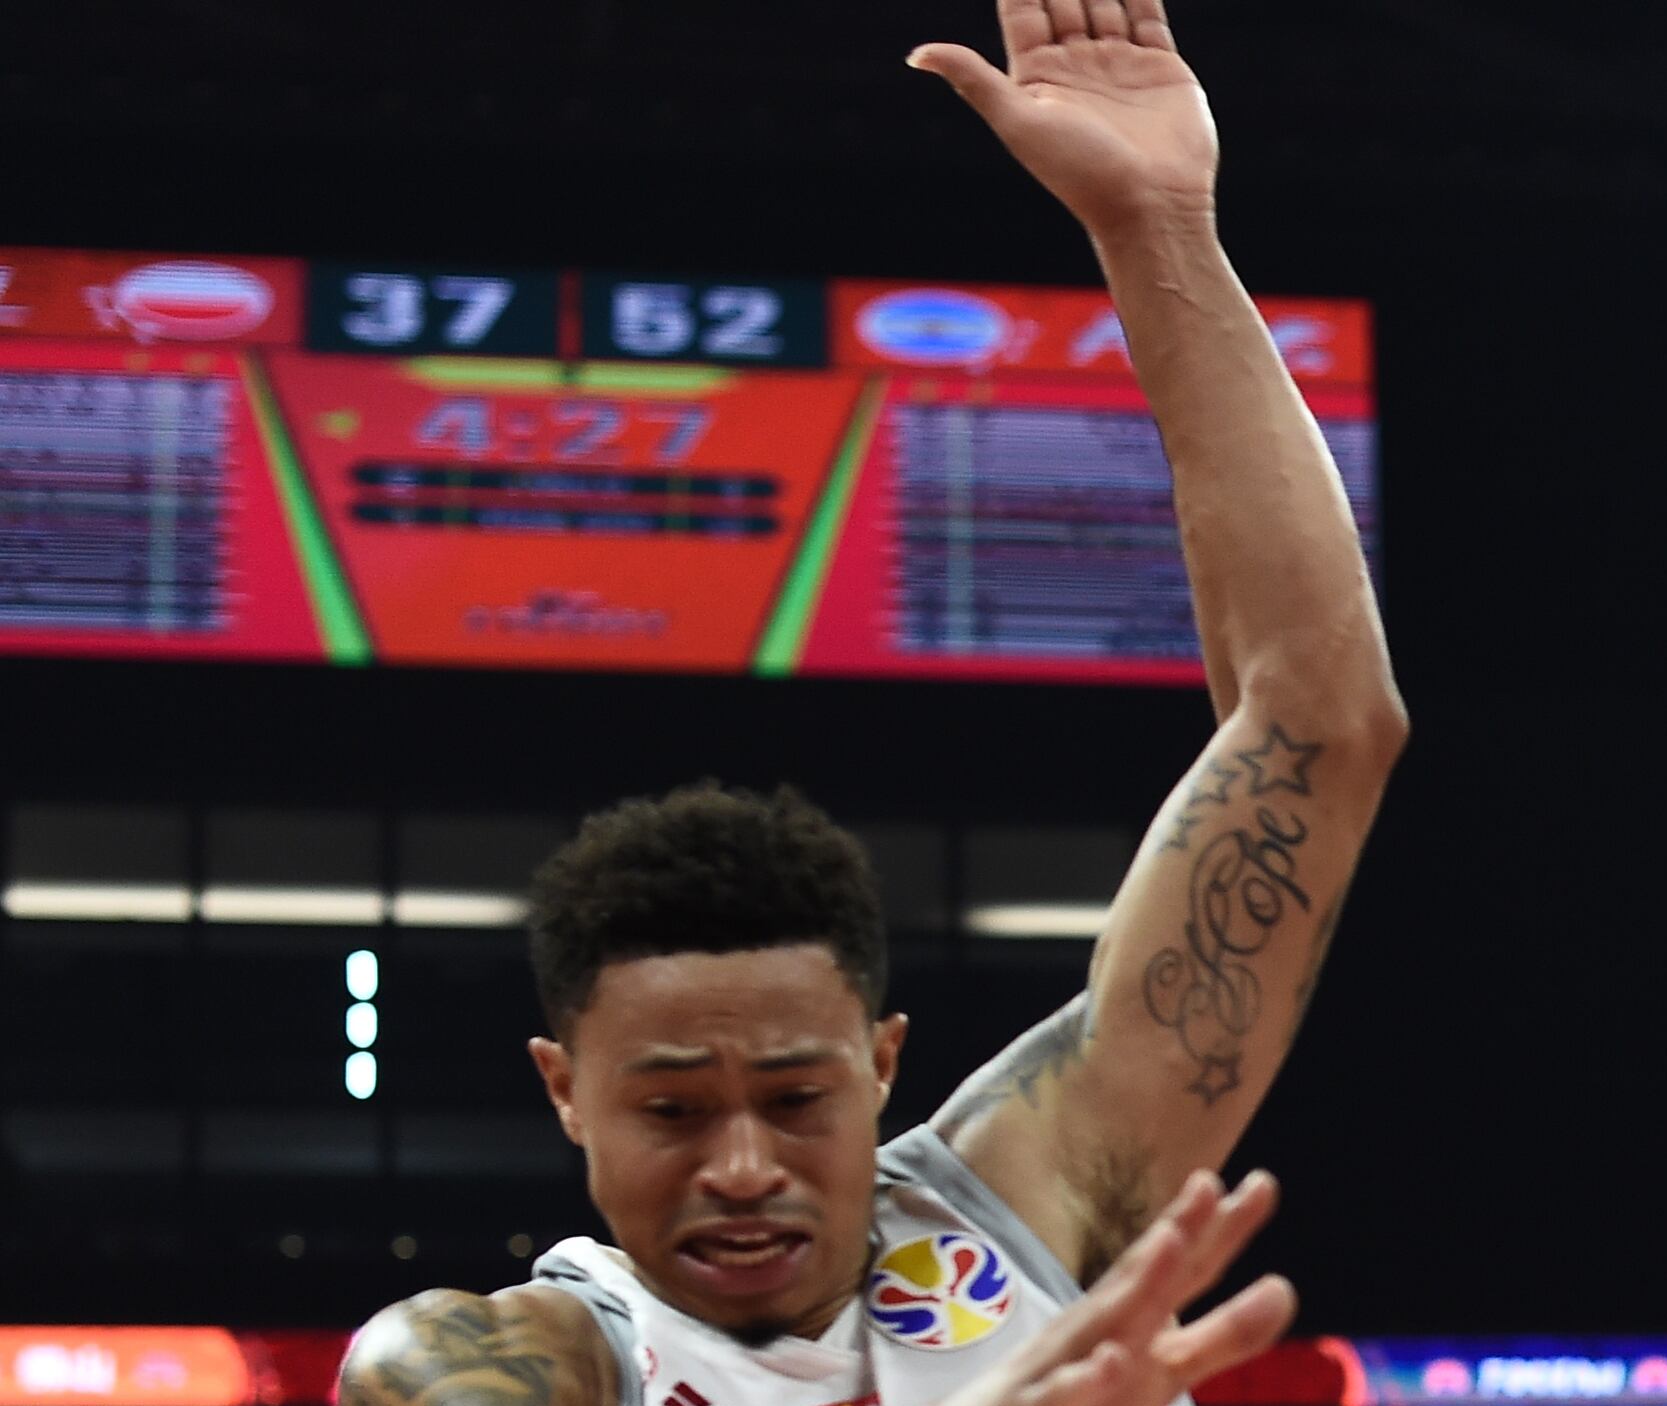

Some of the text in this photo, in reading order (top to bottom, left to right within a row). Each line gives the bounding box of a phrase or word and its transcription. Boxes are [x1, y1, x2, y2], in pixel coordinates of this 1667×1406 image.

[342, 272, 515, 346] 37
[611, 282, 783, 357] 52
[413, 396, 716, 466] 4:27
